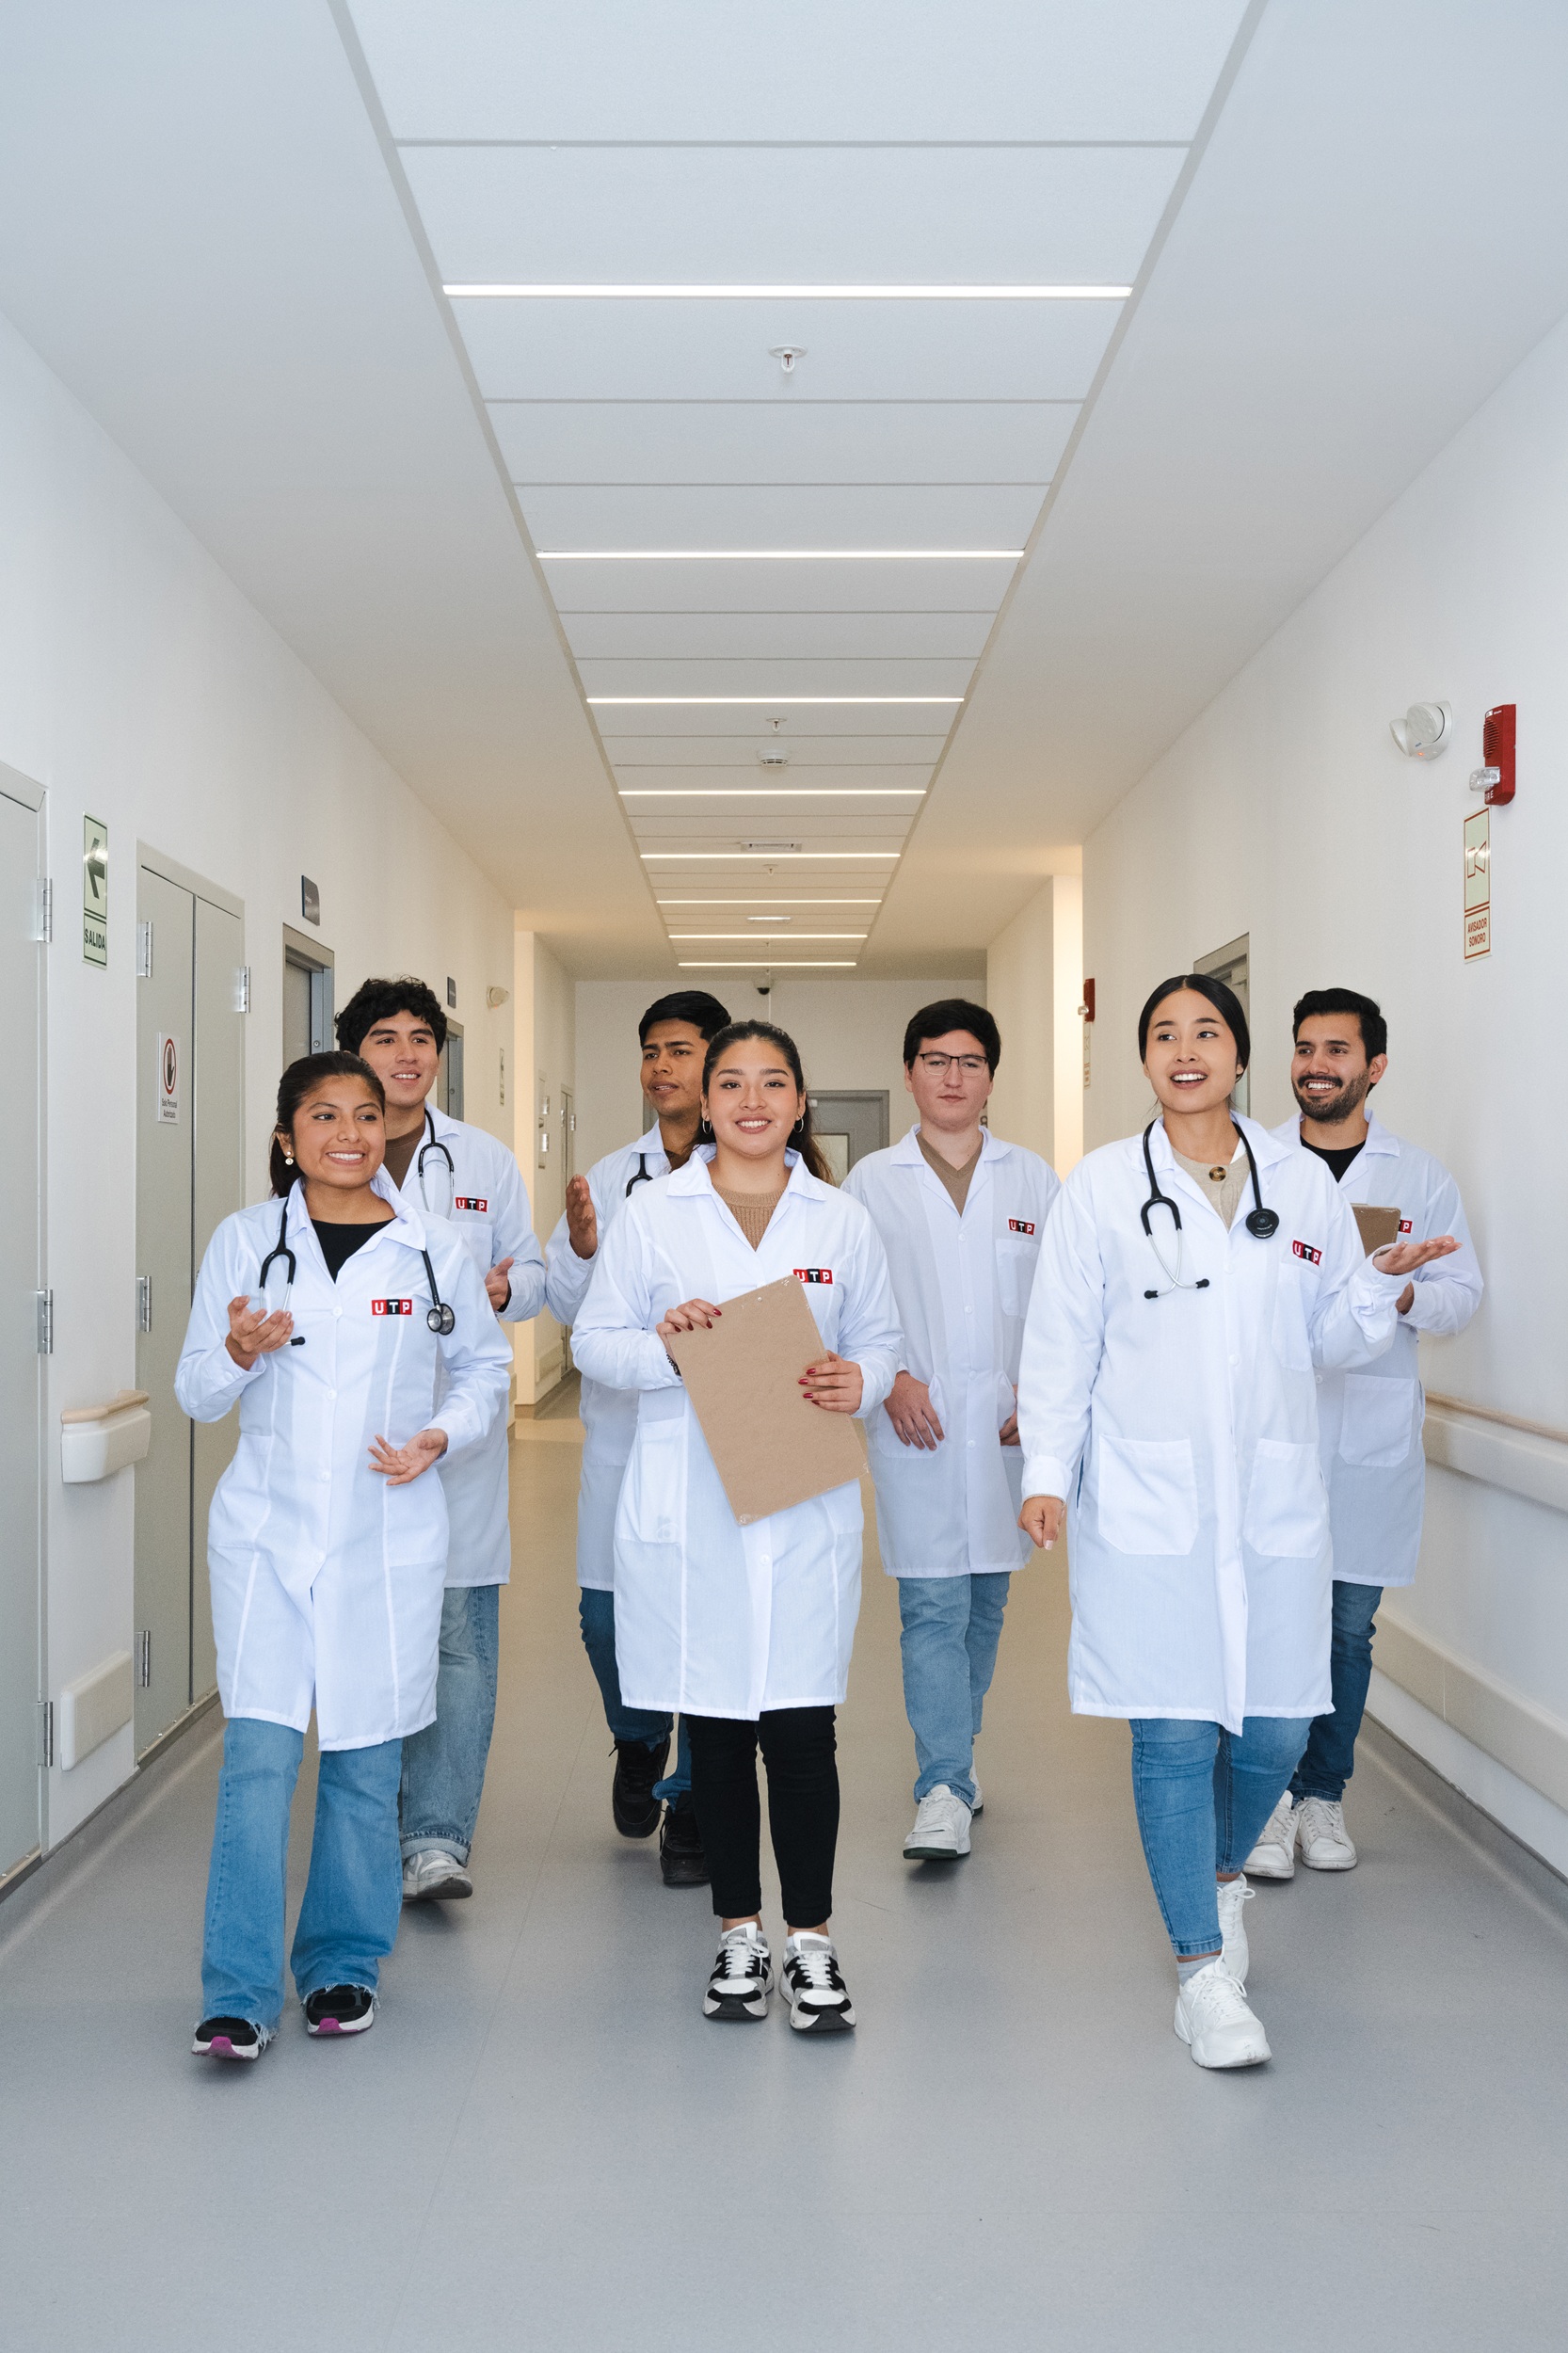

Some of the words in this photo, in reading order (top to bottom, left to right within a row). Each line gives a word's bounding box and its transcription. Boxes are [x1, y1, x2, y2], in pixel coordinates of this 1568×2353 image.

[1467, 917, 1487, 934] AVISADOR
[85, 928, 106, 951] SALIDA
[1469, 932, 1486, 947] SONORO
[457, 1199, 486, 1211] UTP
[1010, 1221, 1033, 1234] UTP
[1294, 1242, 1320, 1263] UTP
[796, 1271, 831, 1283] UTP
[375, 1301, 410, 1314] UTP
